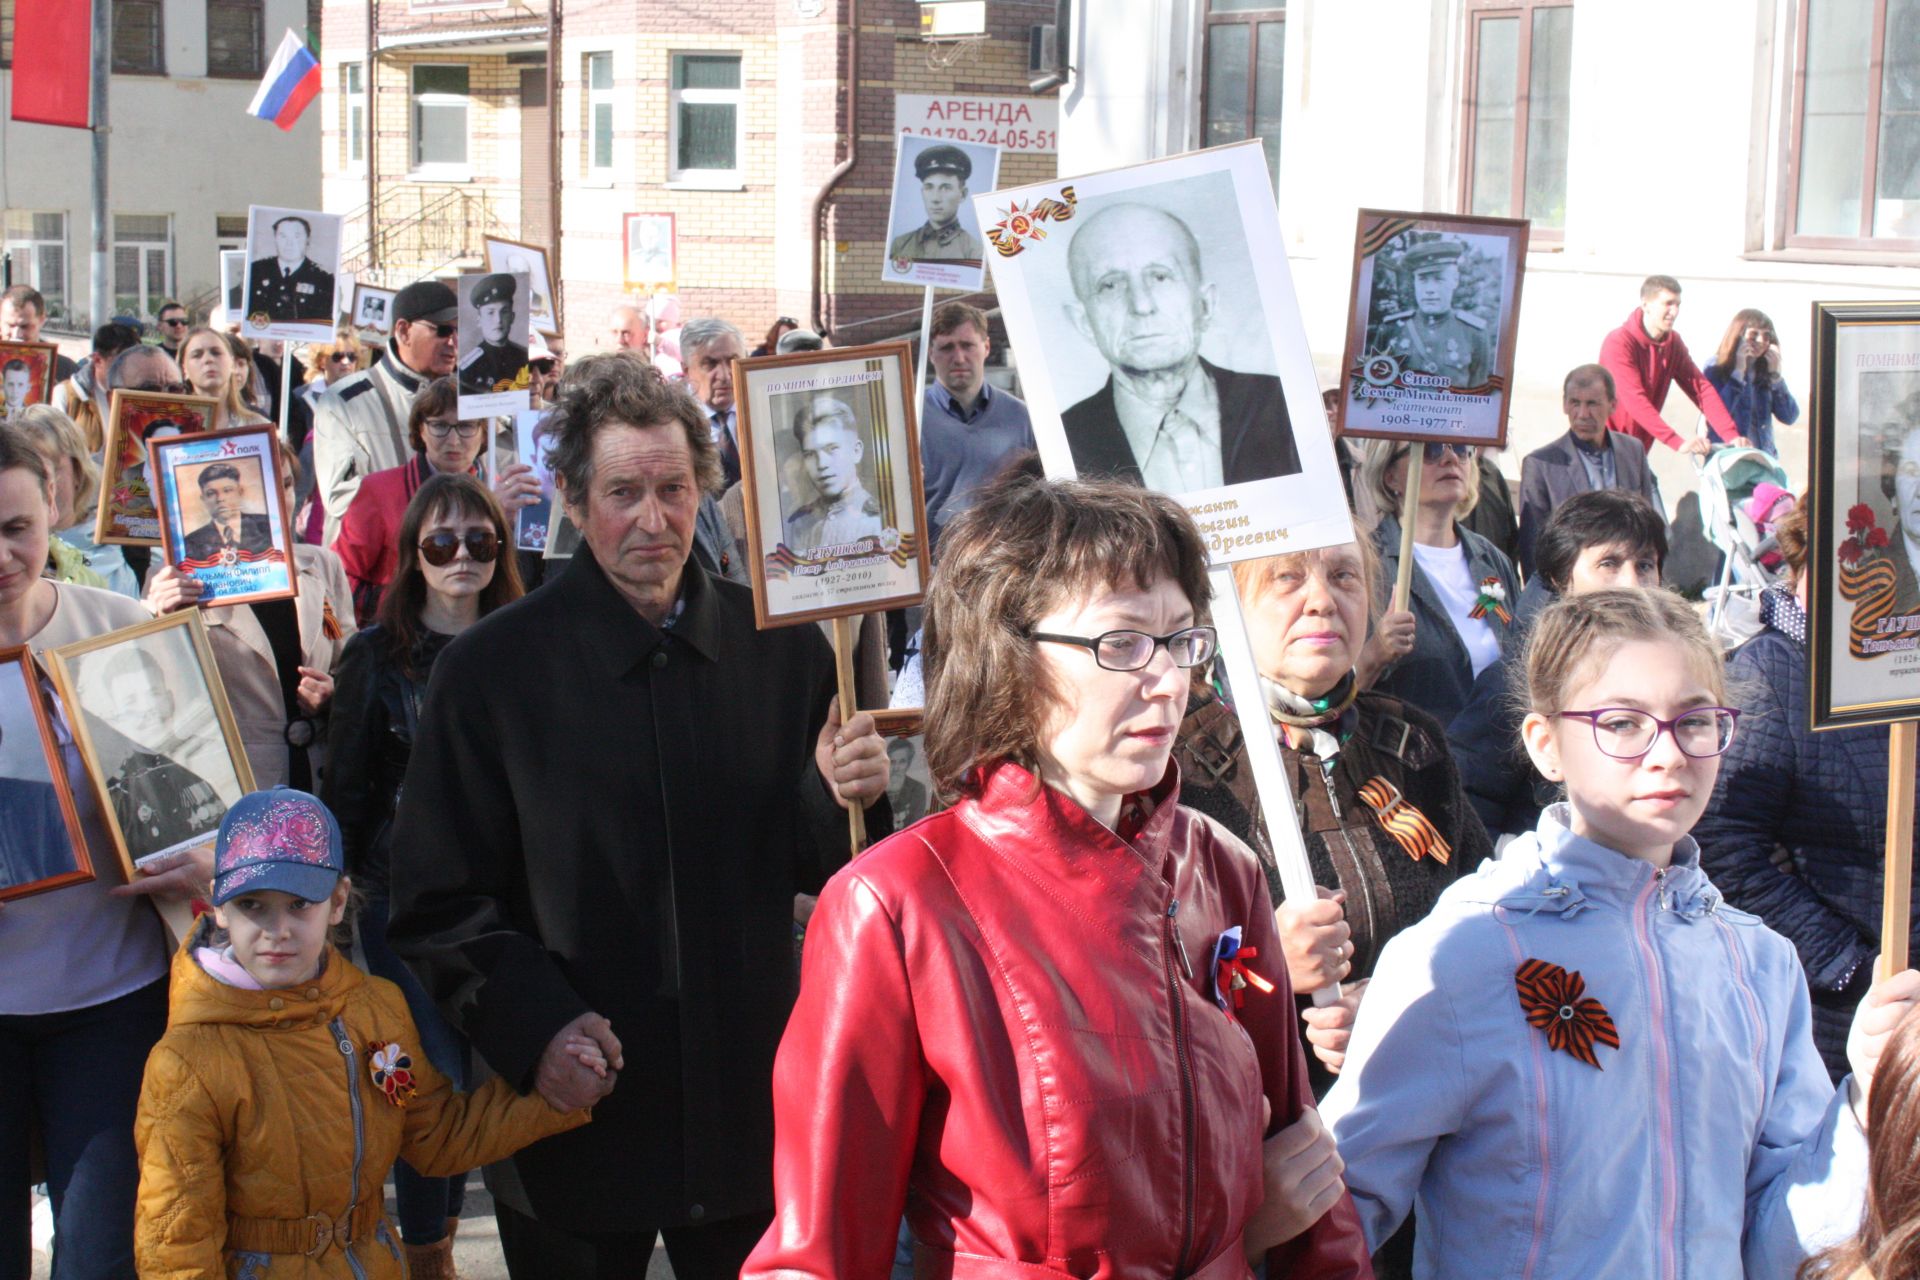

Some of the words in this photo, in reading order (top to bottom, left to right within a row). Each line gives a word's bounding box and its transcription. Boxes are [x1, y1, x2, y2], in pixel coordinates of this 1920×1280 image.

[926, 101, 1032, 126] АРЕНДА
[1402, 371, 1450, 387] Сизов
[1361, 386, 1402, 398] Семён
[1406, 388, 1491, 404] Михайлович
[1388, 402, 1462, 415] лейтенант
[1189, 499, 1238, 515] жант
[1200, 515, 1250, 533] ыгин
[807, 541, 874, 560] ГЛУШКОВ
[1207, 528, 1289, 555] дреевич
[815, 571, 872, 587] (1927-2010)
[1877, 615, 1920, 633] ГЛУШ
